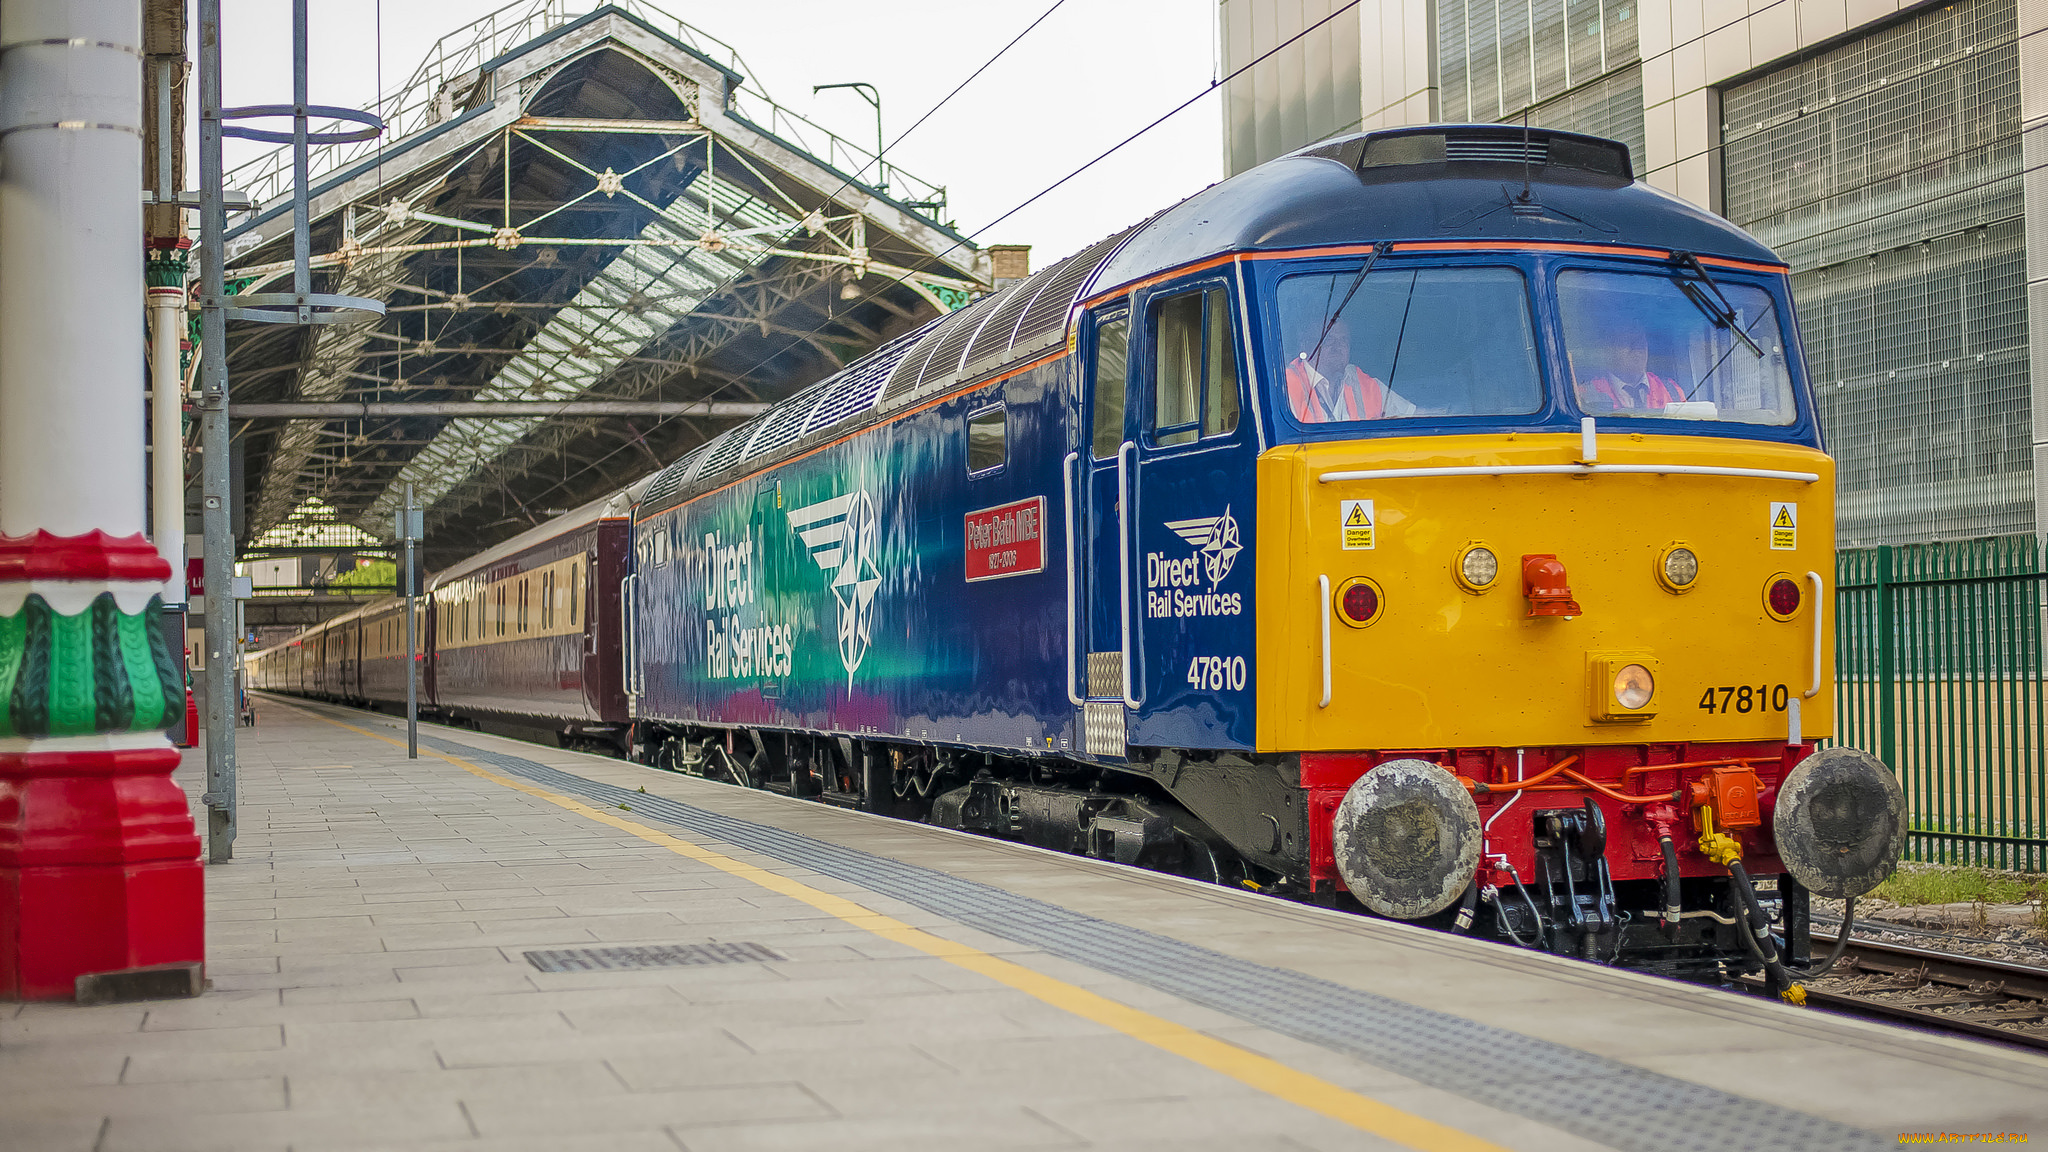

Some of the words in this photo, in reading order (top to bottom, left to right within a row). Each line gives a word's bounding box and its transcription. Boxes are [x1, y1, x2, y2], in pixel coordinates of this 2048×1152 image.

[967, 519, 992, 551] Peter
[992, 512, 1016, 547] Bath
[1016, 506, 1039, 543] MBE
[705, 523, 754, 612] Direct
[1147, 550, 1200, 588] Direct
[1147, 589, 1172, 619] Rail
[1174, 587, 1242, 618] Services
[706, 616, 729, 679] Rail
[731, 610, 792, 679] Services
[1187, 655, 1247, 692] 47810
[1698, 683, 1789, 715] 47810
